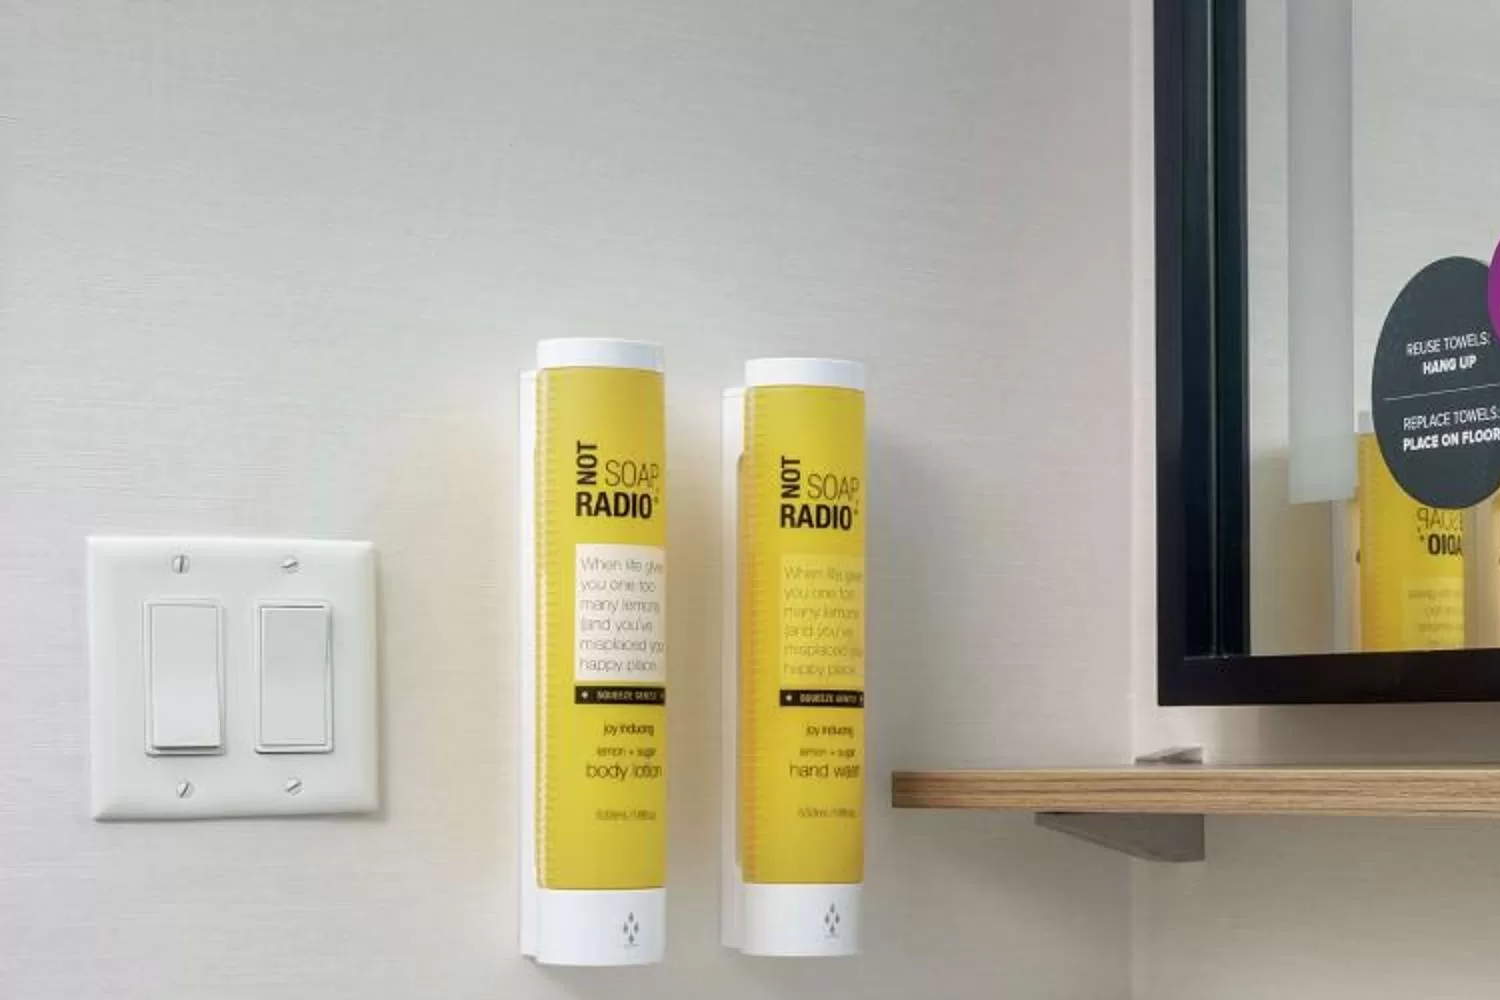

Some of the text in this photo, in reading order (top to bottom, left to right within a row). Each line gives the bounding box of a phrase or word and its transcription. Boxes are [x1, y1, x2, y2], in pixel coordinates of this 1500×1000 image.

[1406, 330, 1491, 356] REUSE TOWELS:
[1423, 355, 1477, 375] HANG UP
[1403, 405, 1500, 431] REPLACE TOWELS:
[1403, 428, 1500, 452] PLACE ON FLOOR
[576, 440, 598, 485] NOT
[780, 455, 801, 499] NOT
[576, 491, 652, 519] RADIO
[780, 503, 852, 531] RADIO
[581, 556, 622, 572] When
[580, 579, 607, 593] you
[580, 599, 623, 615] many
[580, 659, 623, 673] happy
[603, 721, 618, 737] joy
[585, 763, 663, 782] body lotion
[789, 762, 829, 779] hand
